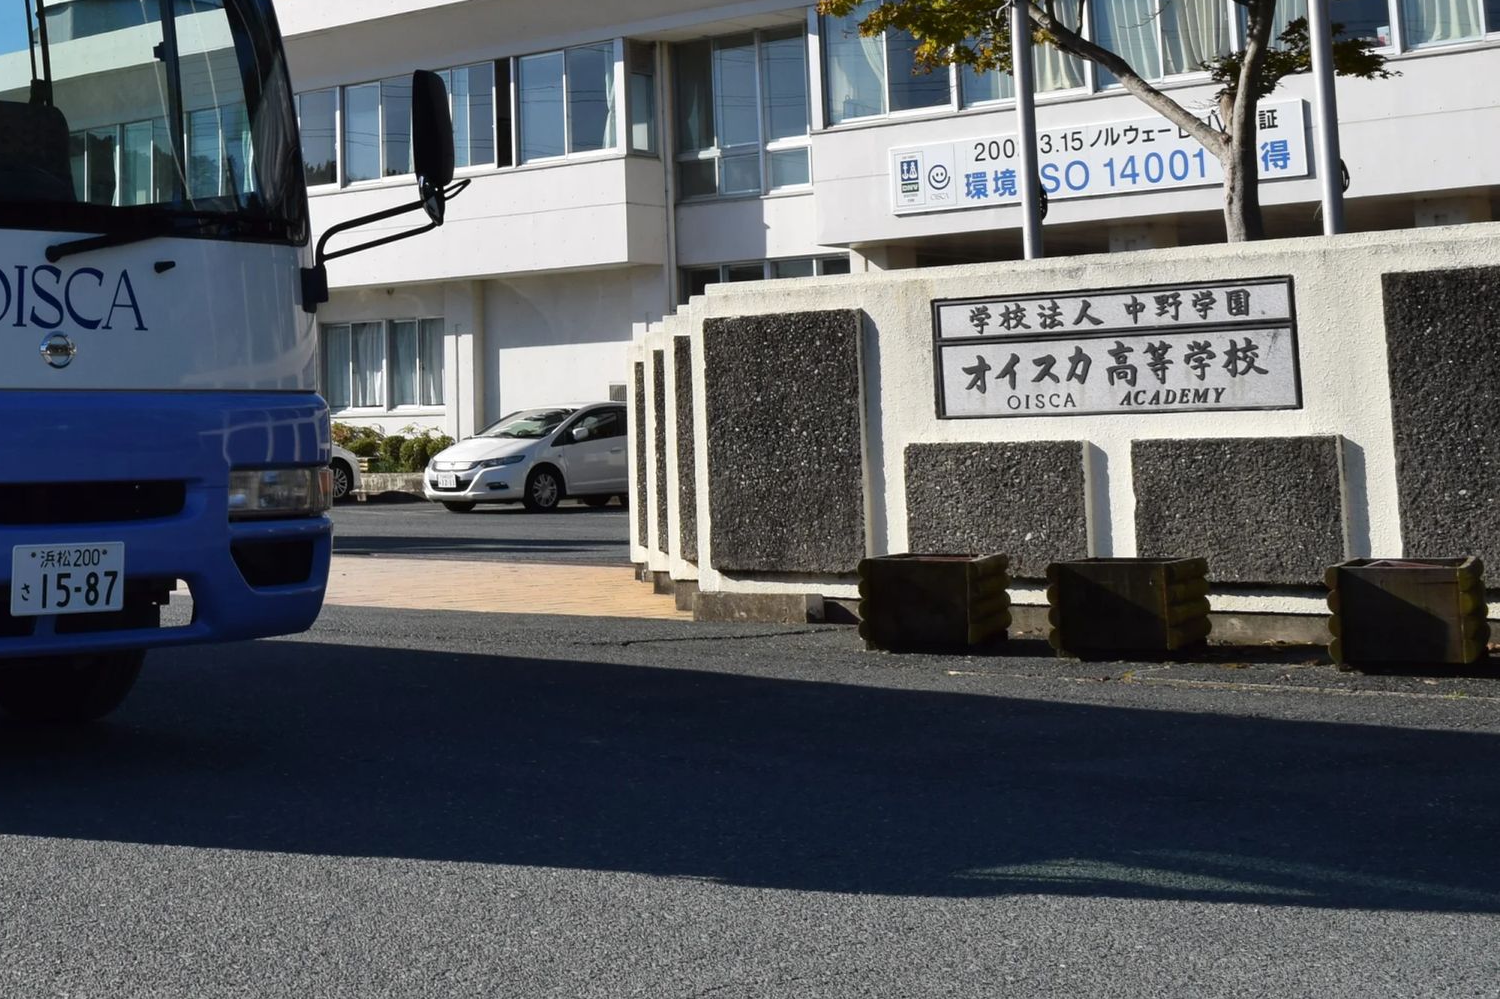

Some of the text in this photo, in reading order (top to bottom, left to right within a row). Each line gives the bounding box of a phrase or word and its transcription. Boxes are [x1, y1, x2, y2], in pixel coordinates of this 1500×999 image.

[1103, 148, 1205, 187] 14001
[969, 288, 1251, 335] 学校法人 中野学園
[962, 337, 1269, 394] オイスカ高等学校
[1007, 387, 1227, 410] OISCA ACADEMY
[42, 571, 118, 608] 15-87
